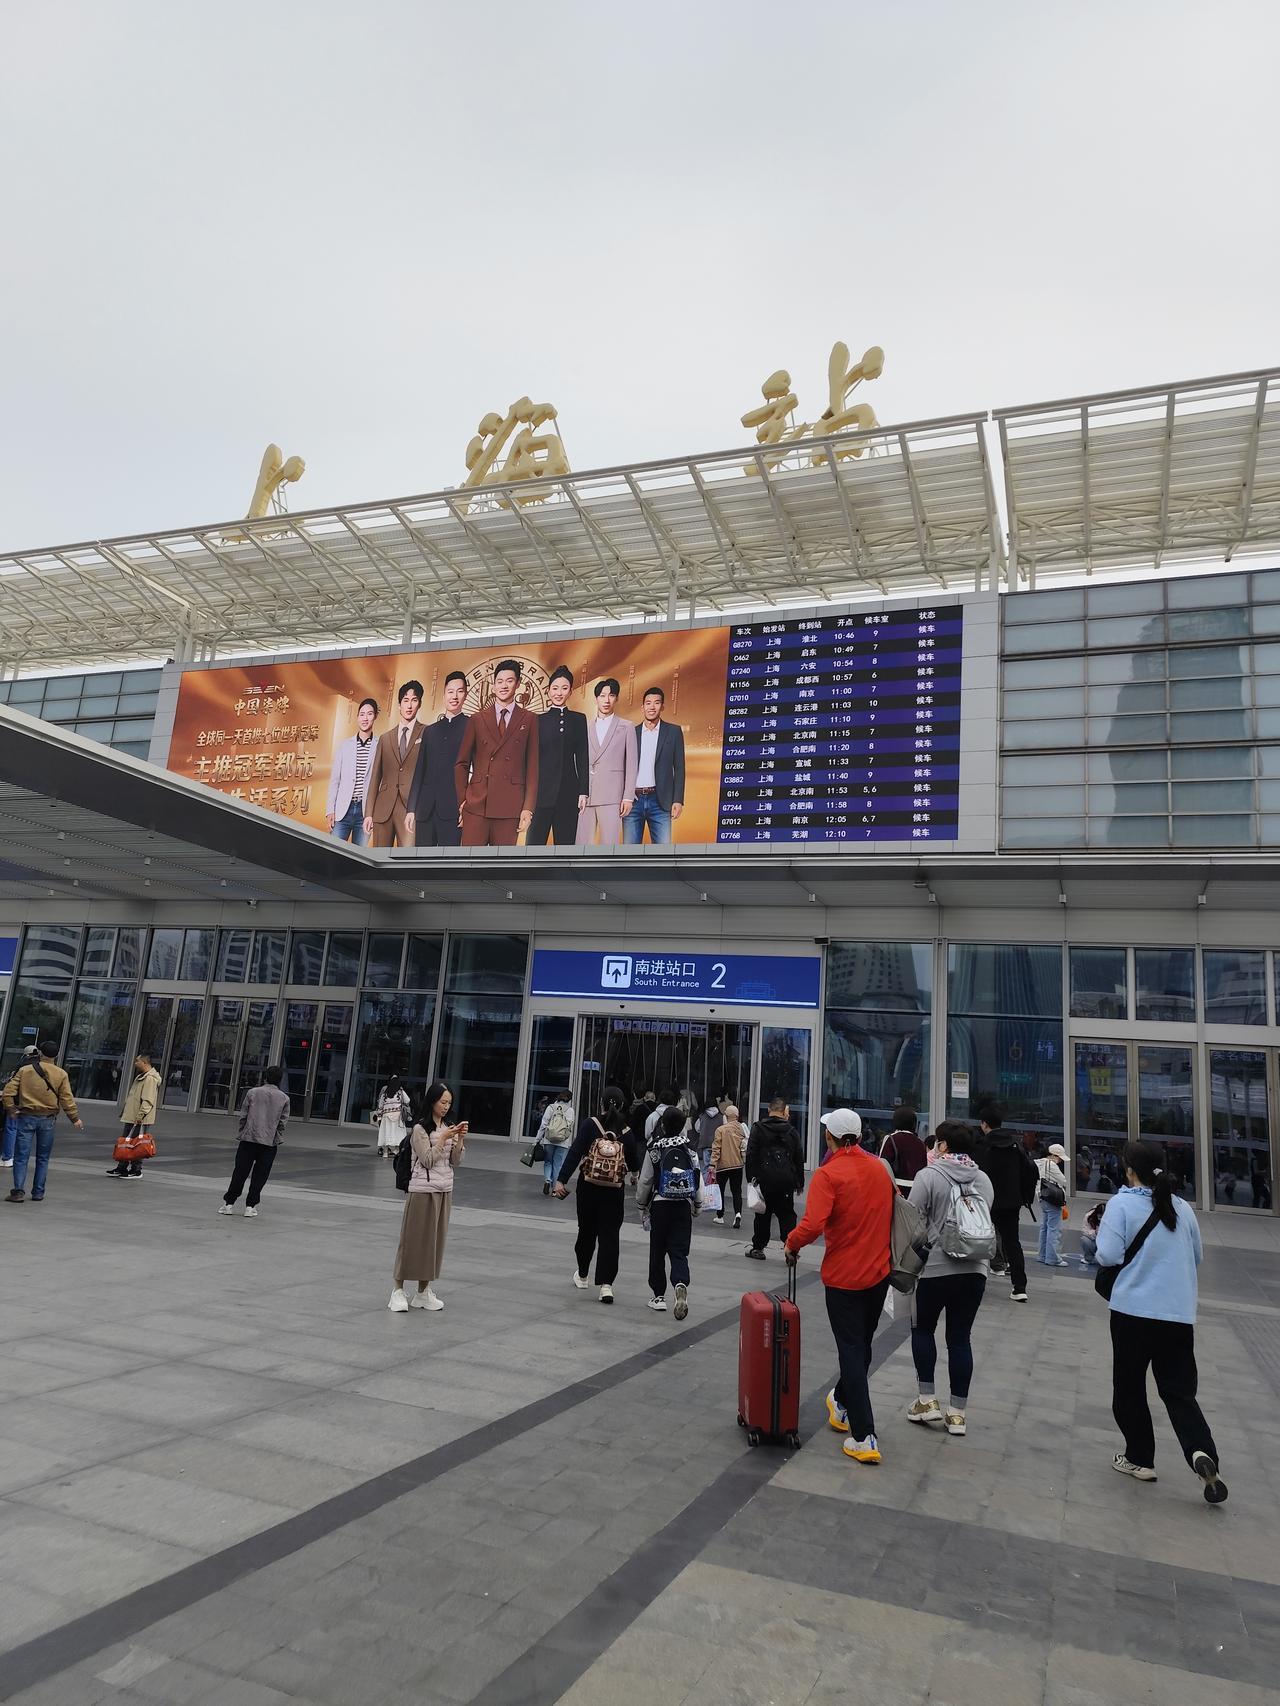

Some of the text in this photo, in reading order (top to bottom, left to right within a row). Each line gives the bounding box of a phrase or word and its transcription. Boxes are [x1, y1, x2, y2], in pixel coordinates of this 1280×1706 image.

[736, 610, 936, 636] 车次 始发站 终到站 开点 候车室 状态
[732, 640, 753, 649] G8270
[766, 637, 782, 647] 上海
[834, 631, 855, 640] 10:46
[873, 629, 879, 637] 9
[918, 624, 936, 634] 候车
[733, 654, 750, 662] C462
[765, 651, 781, 660] 上海
[833, 645, 854, 654] 10:49
[873, 643, 878, 651] 7
[917, 638, 935, 648] 候车
[731, 652, 935, 675] G7240 上海 六安 10:54 8 候车
[730, 667, 935, 689] K1156 上海 成都西 10:57 6 候车
[729, 681, 935, 702] G7010 上海 南京 11:00 7 候车
[234, 695, 290, 717] 中国柒牌
[728, 695, 934, 716] G8282 上海 连云港 11:03 10 候车
[729, 710, 934, 729] K234 上海 石家庄 11:10 9 候车
[196, 725, 319, 747] 全球同一天首推七位世界冠军
[728, 735, 745, 743] G734
[760, 732, 777, 742] 上海
[792, 730, 817, 740] 北京南
[829, 729, 851, 737] 11:15
[915, 724, 933, 734] 候车
[759, 746, 776, 756] 上海
[792, 744, 817, 754] 合肥南
[829, 743, 850, 751] 11:20
[868, 742, 874, 750] 8
[914, 739, 933, 749] 候车
[194, 751, 317, 784] 主推冠军都市
[724, 753, 933, 770] G7282 上海 宣城 11:33 7 候车
[757, 774, 774, 783] 上海
[794, 773, 811, 782] 盐城
[827, 772, 849, 780] 11:40
[867, 771, 873, 779] 9
[913, 768, 932, 778] 候车
[726, 783, 932, 798] G16 上海 北京南 11:53 5,6 候车
[722, 798, 931, 812] G7244 上海 合肥南 11:58 8 候车
[721, 813, 931, 826] G7012 上海 南京 12:05 6,7 候车
[720, 832, 741, 840] G7768
[754, 830, 771, 840] 上海
[825, 830, 847, 838] 12:10
[866, 829, 871, 837] 7
[912, 828, 930, 838] 候车
[635, 959, 695, 977] 南进站口
[710, 963, 727, 989] 2
[634, 977, 700, 988] South Entrance
